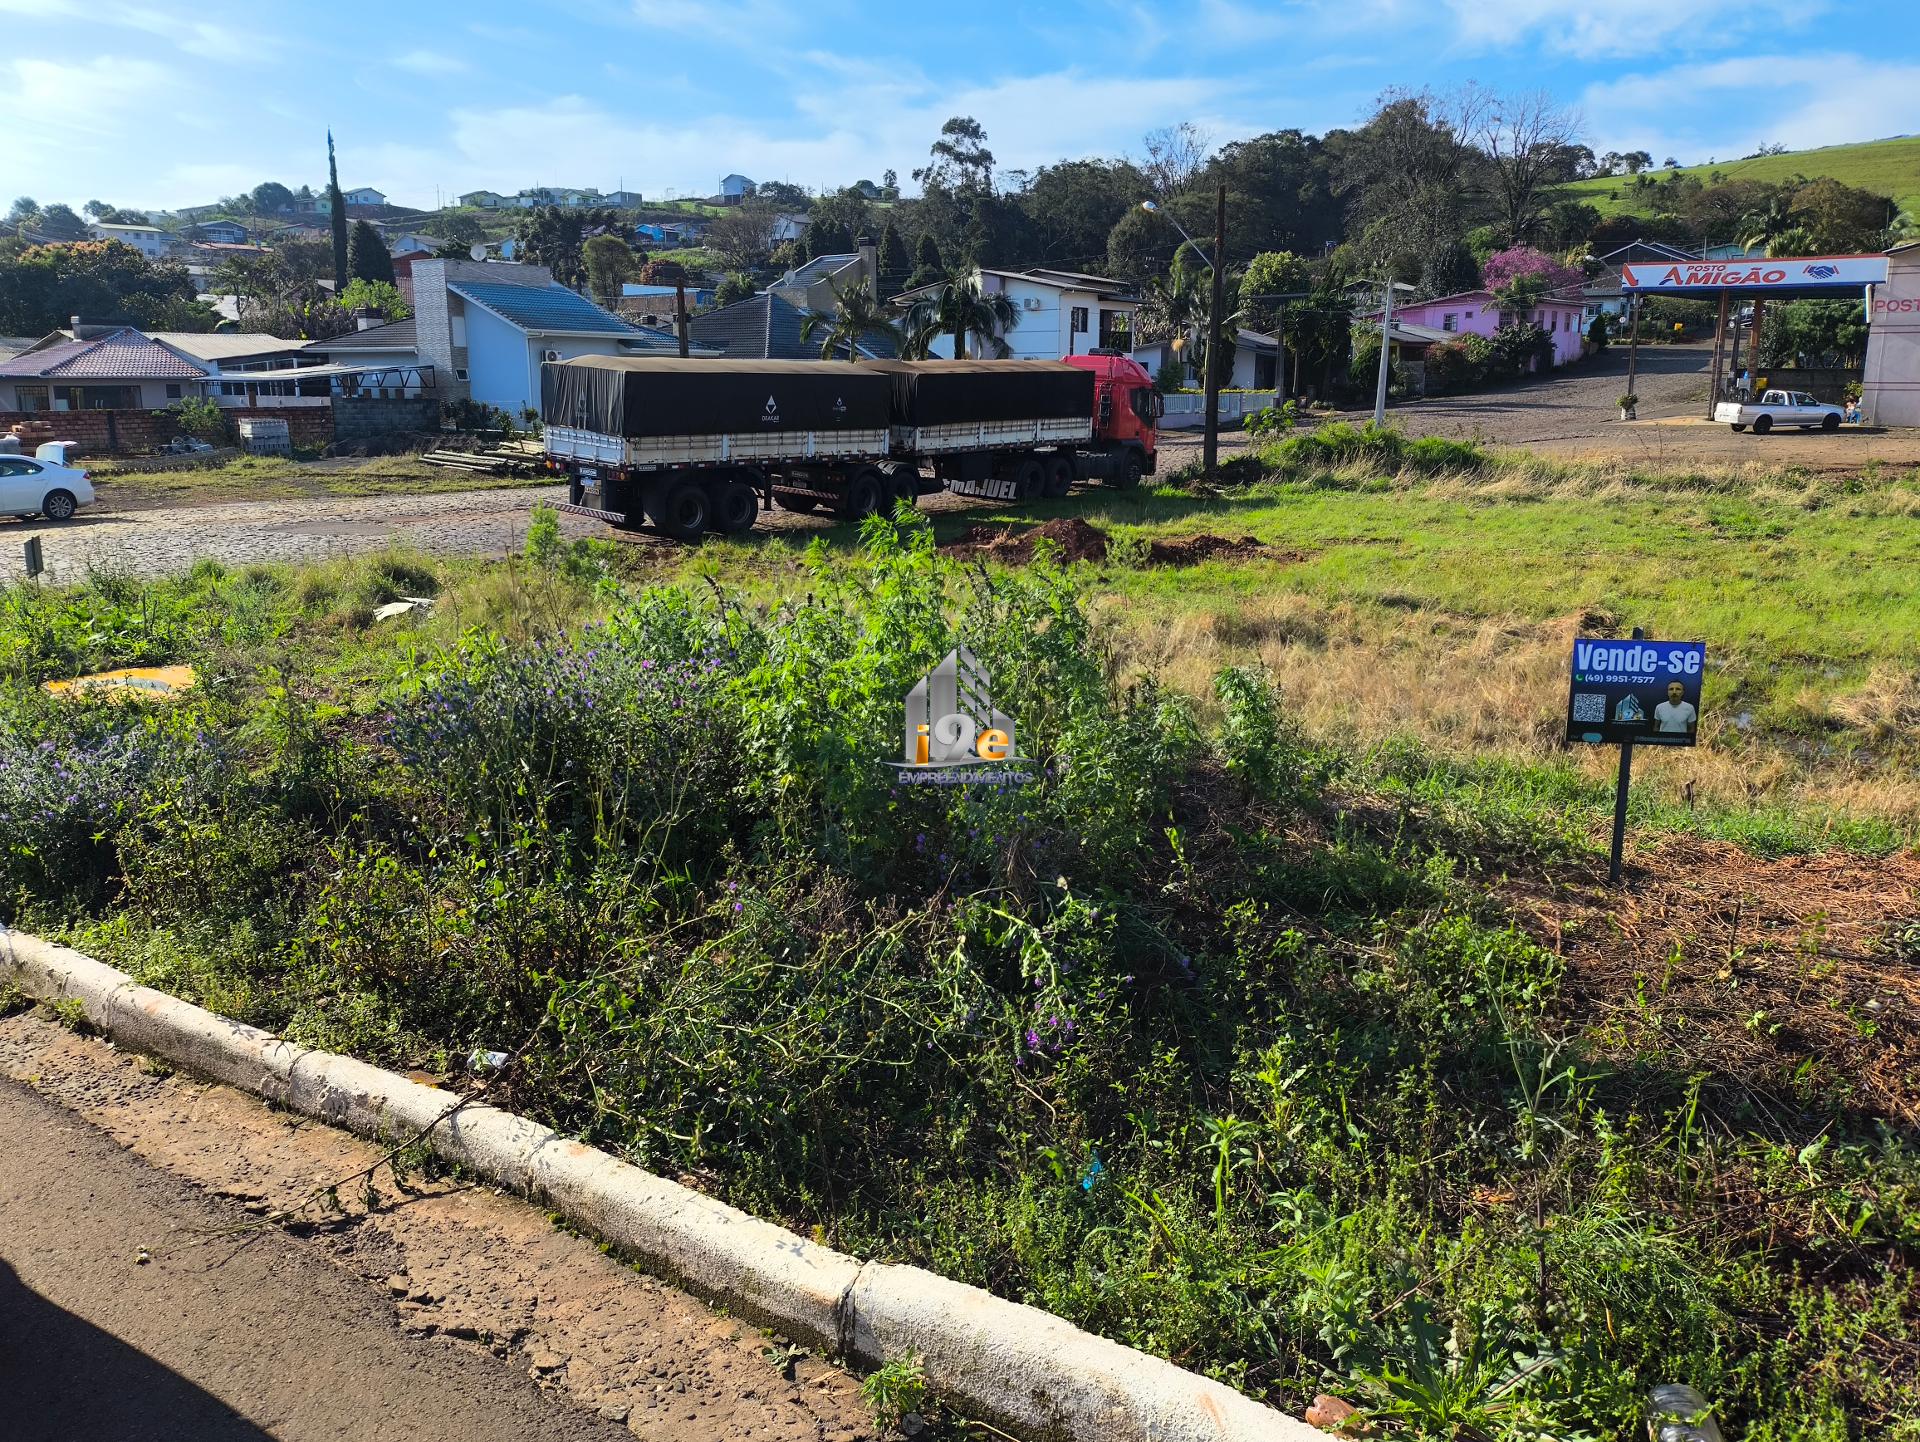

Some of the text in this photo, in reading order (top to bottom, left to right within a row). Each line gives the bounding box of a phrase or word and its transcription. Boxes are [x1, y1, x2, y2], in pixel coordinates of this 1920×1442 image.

[1659, 266, 1786, 286] AMIGÃO
[1577, 643, 1700, 674] Vende-se
[1585, 674, 1604, 683] (49)
